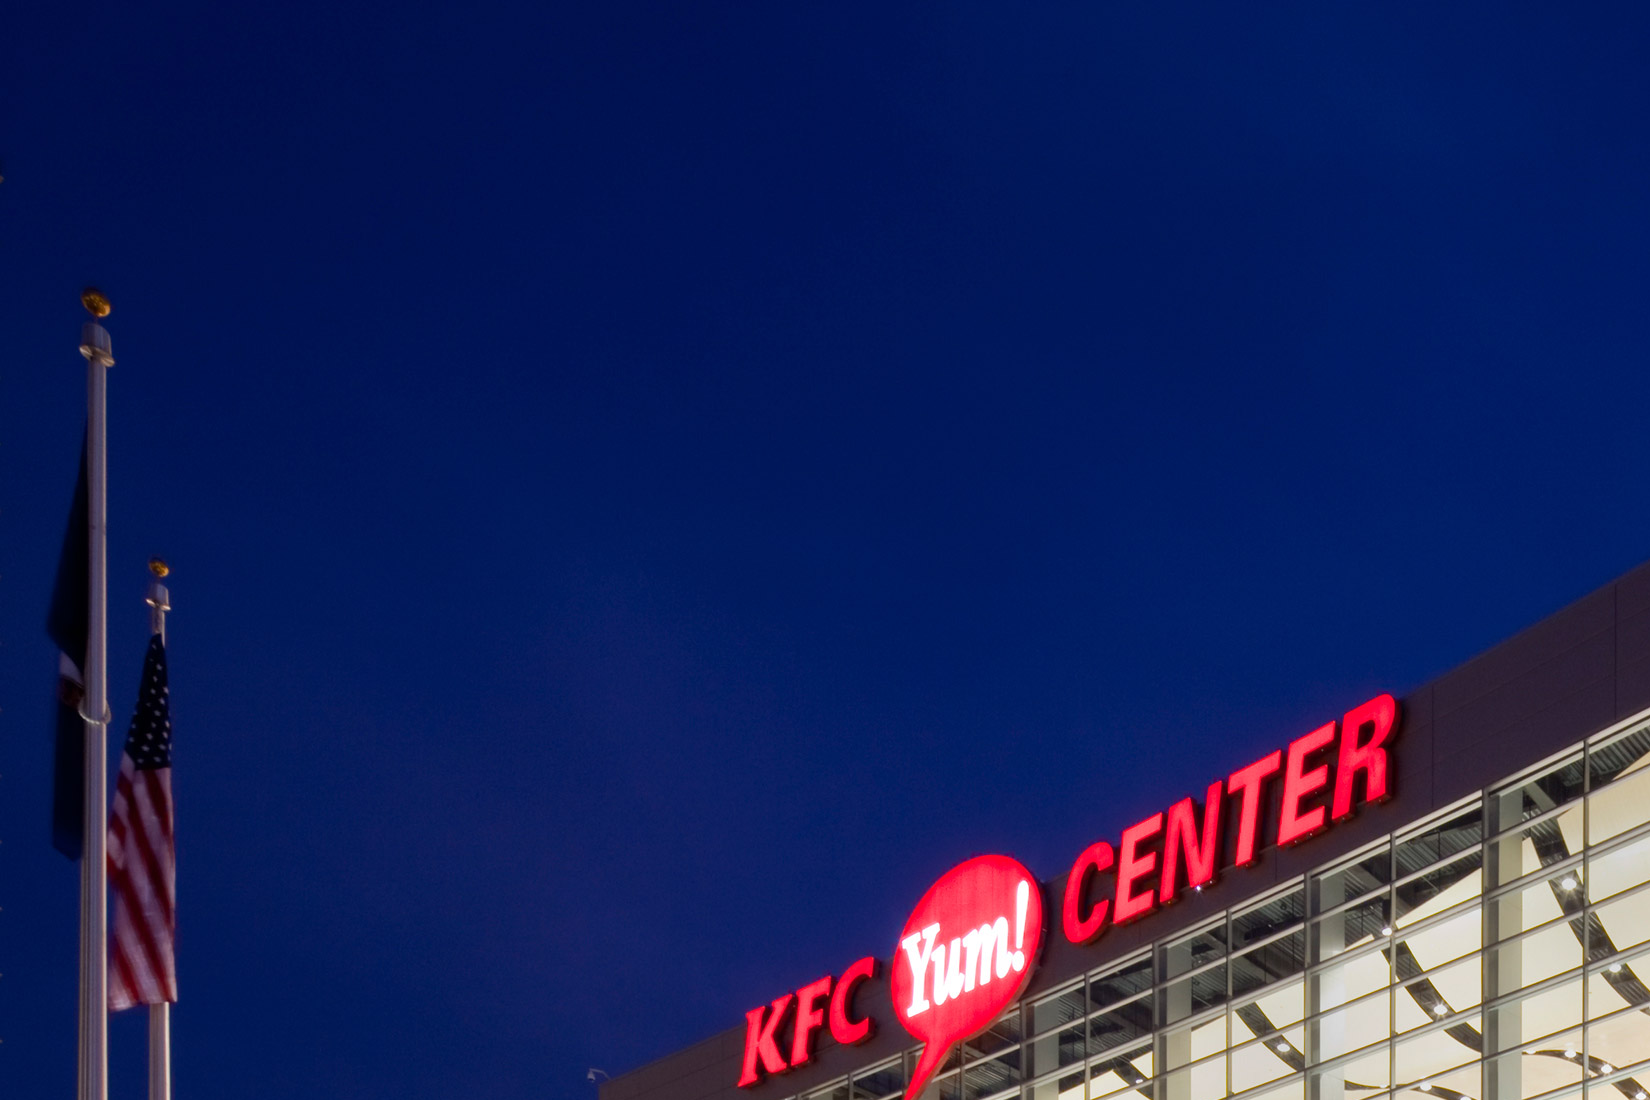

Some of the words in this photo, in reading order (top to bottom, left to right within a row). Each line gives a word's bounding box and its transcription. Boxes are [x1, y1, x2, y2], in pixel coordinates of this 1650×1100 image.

[738, 957, 875, 1088] KFC
[902, 880, 1029, 1017] Yum!
[1062, 694, 1397, 946] CENTER
